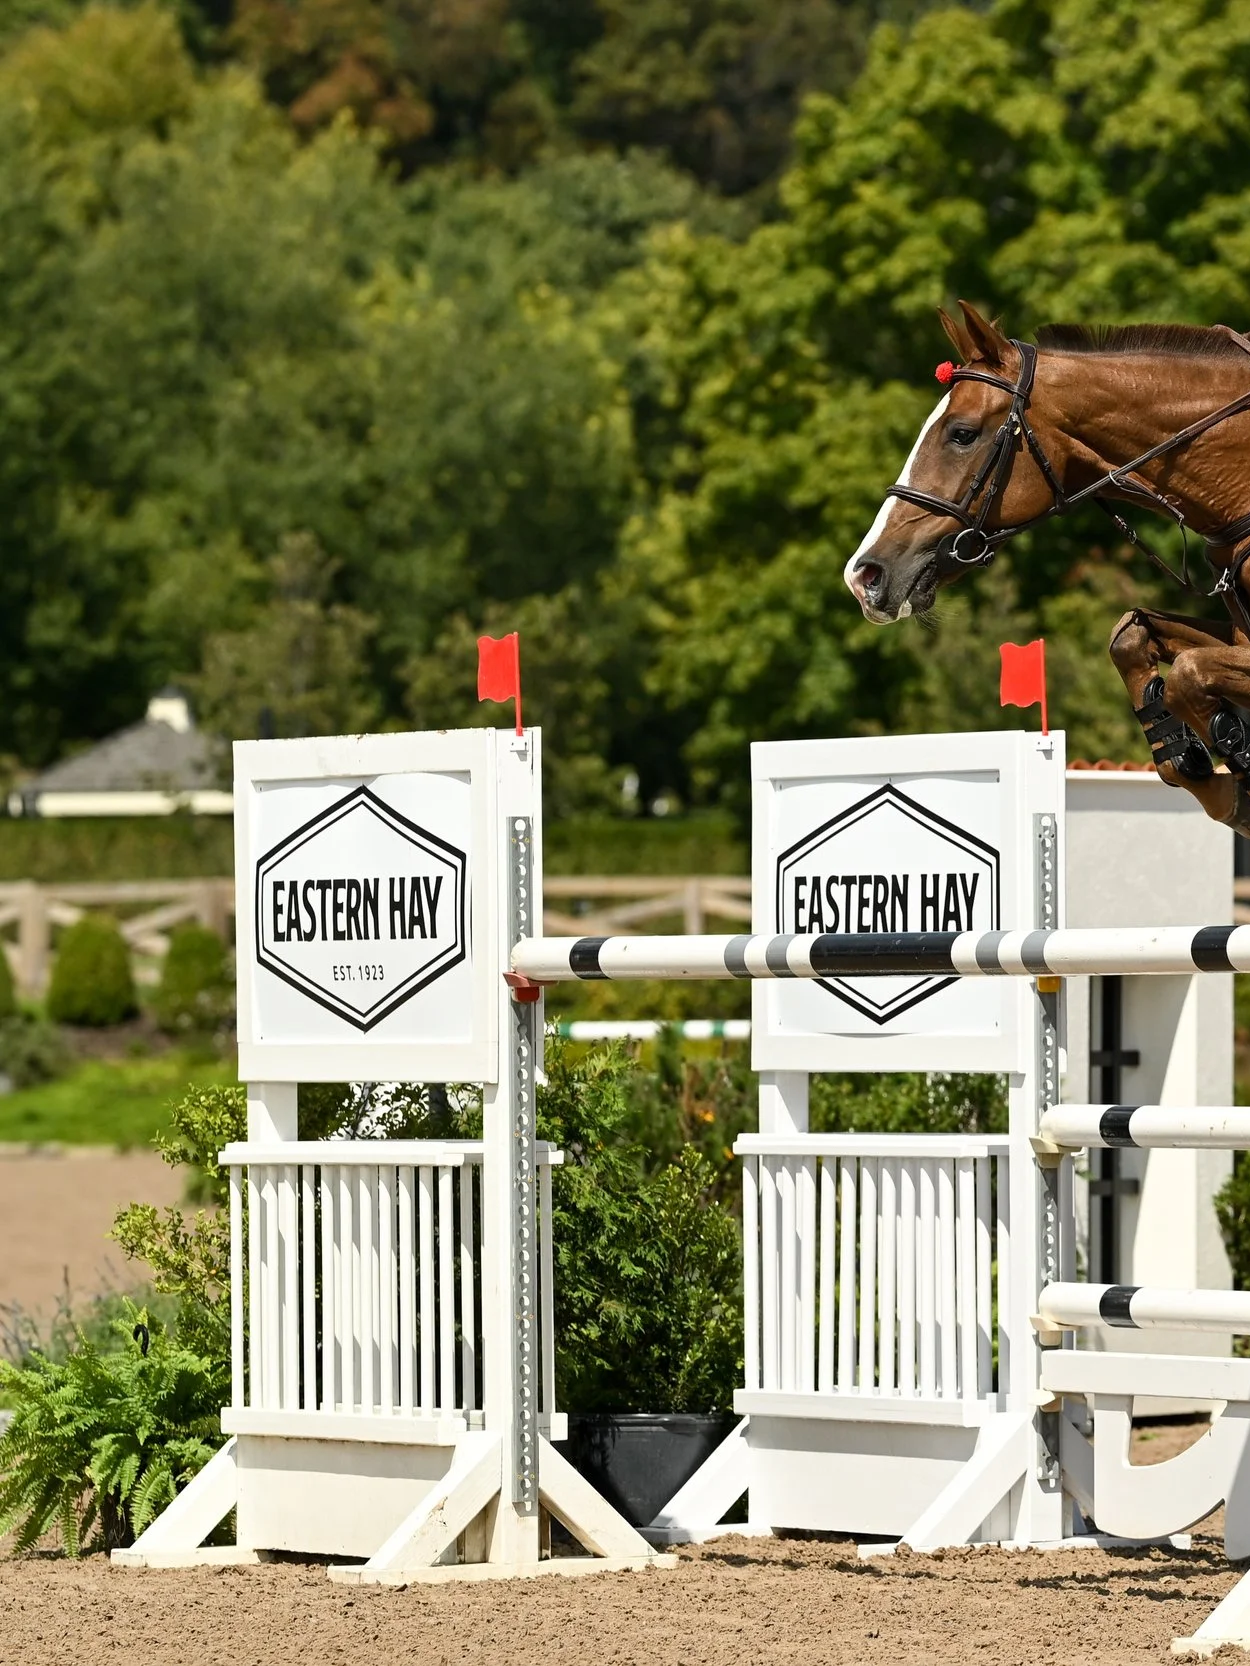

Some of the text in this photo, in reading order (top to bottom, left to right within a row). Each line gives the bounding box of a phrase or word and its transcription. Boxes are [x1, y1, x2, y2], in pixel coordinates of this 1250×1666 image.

[272, 875, 444, 943] EASTERN HAY
[794, 872, 980, 934] EASTERN HAY
[332, 964, 385, 982] EST. 1923
